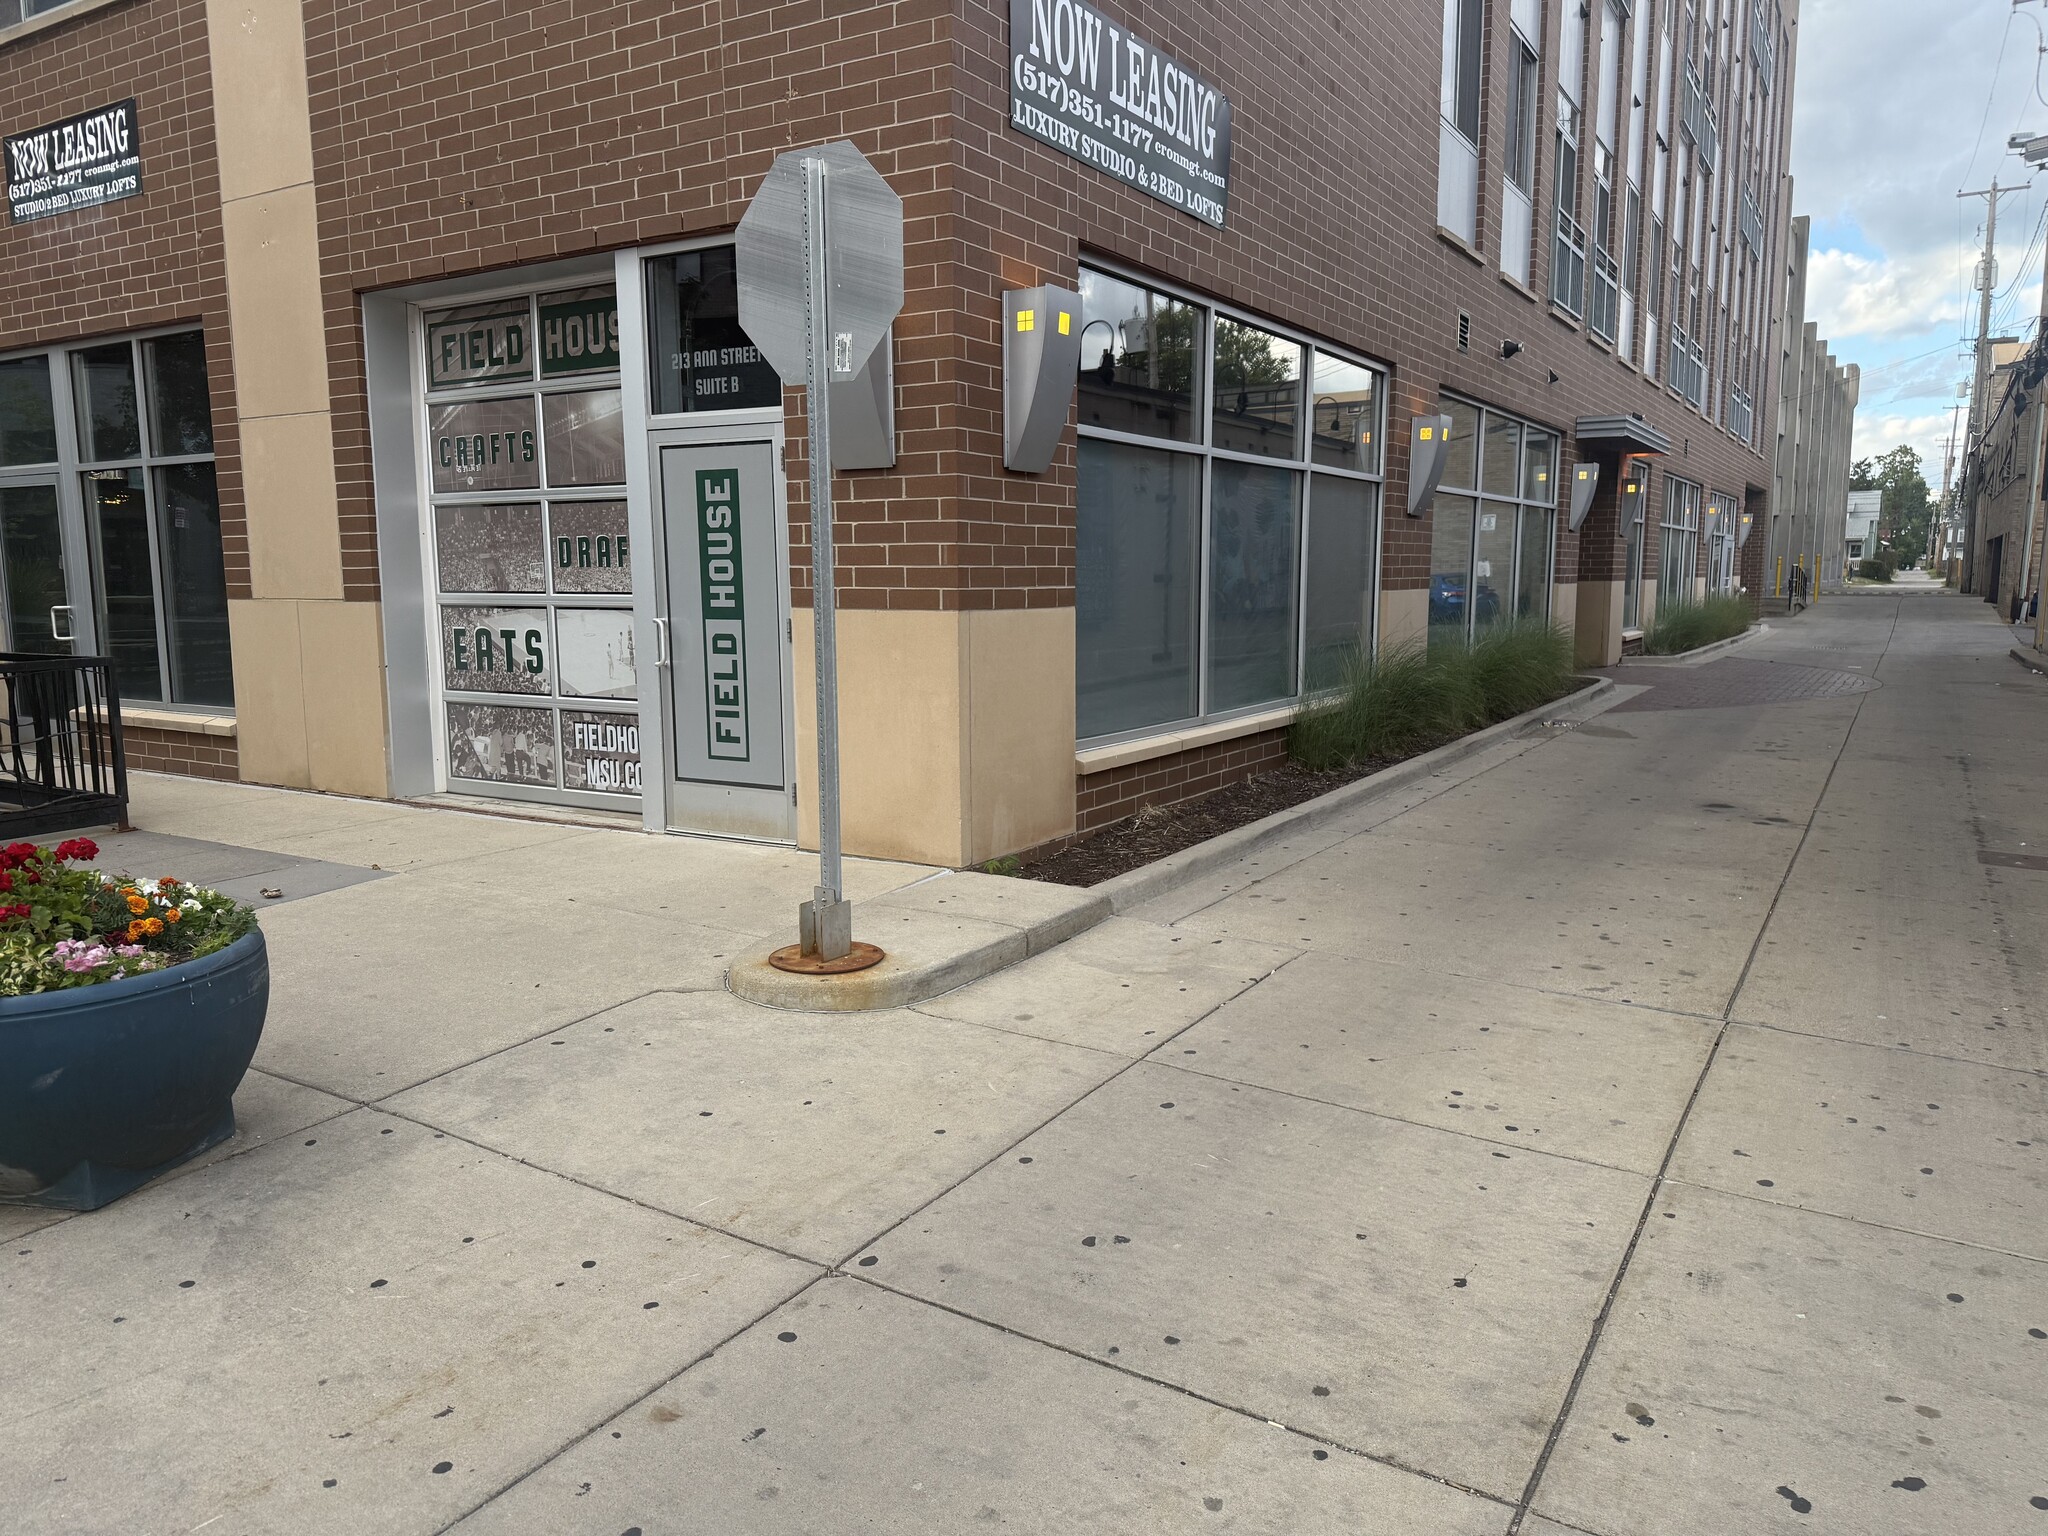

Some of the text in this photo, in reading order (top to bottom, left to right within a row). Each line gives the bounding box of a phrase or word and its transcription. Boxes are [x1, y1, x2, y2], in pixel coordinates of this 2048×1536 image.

[1029, 0, 1217, 160] NOW LEASING
[11, 108, 129, 180] NOW LEASING
[1014, 53, 1226, 189] (517)351-1177 cronmgt.com
[8, 155, 140, 201] (517)351-1177 cronmgt.com
[1014, 98, 1080, 152] LUXURY
[1081, 134, 1136, 181] STUDIO
[1137, 164, 1149, 187] &
[1186, 188, 1224, 224] LOFTS
[69, 184, 105, 204] LUXURY
[106, 175, 137, 194] LOFTS
[441, 325, 524, 373] FIELD
[671, 352, 691, 370] 213
[693, 349, 718, 368] ANN
[695, 376, 740, 396] SUITE B
[438, 429, 534, 468] CRAFTS
[704, 477, 741, 744] FIELD HOUSE
[453, 626, 544, 674] EATS
[573, 722, 641, 754] FIELDHO
